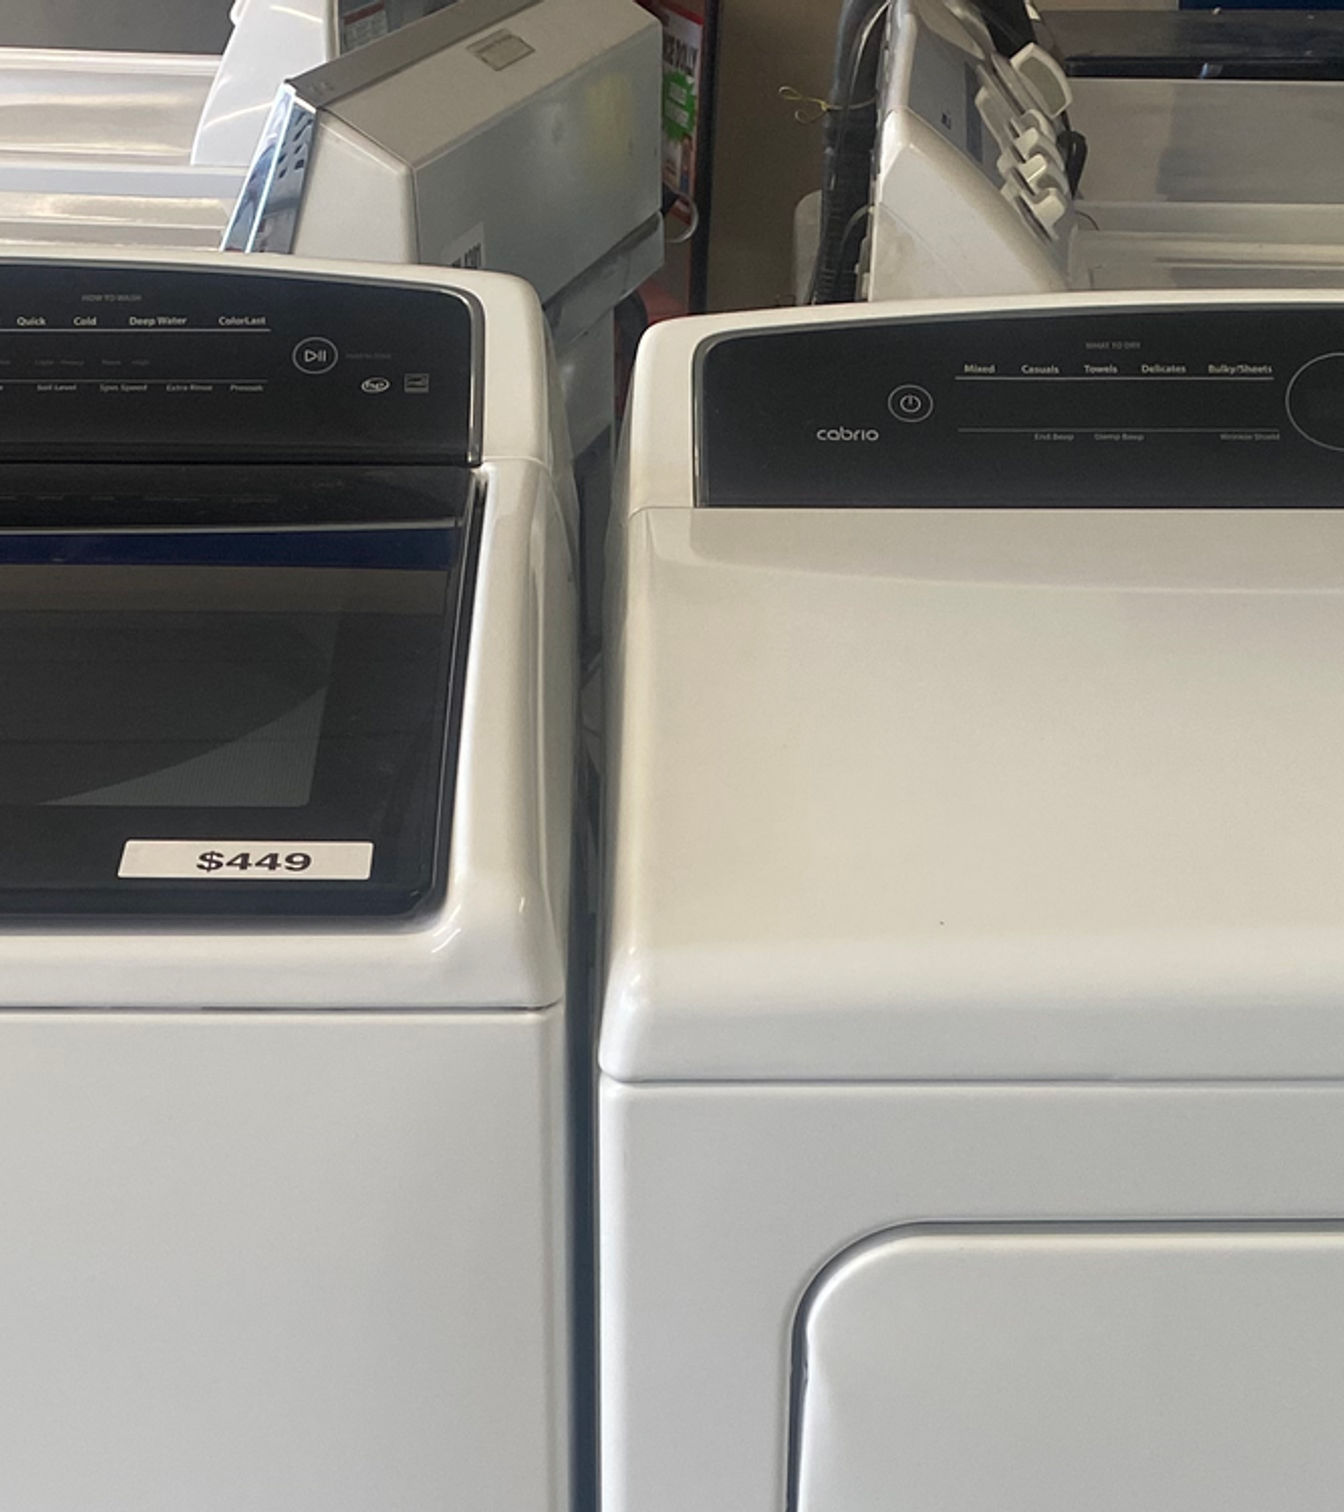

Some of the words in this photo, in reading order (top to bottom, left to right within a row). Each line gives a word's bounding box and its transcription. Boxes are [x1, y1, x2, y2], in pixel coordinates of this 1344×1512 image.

[17, 316, 46, 326] Quick
[73, 316, 97, 326] Cold
[129, 316, 156, 328] Deep
[156, 316, 188, 326] Water
[964, 363, 996, 374] Mixed
[1021, 364, 1059, 374] Casuals
[1084, 364, 1118, 374] Towels
[1141, 363, 1186, 374] Delicates
[816, 426, 880, 441] cabrio
[196, 851, 312, 873] $449
